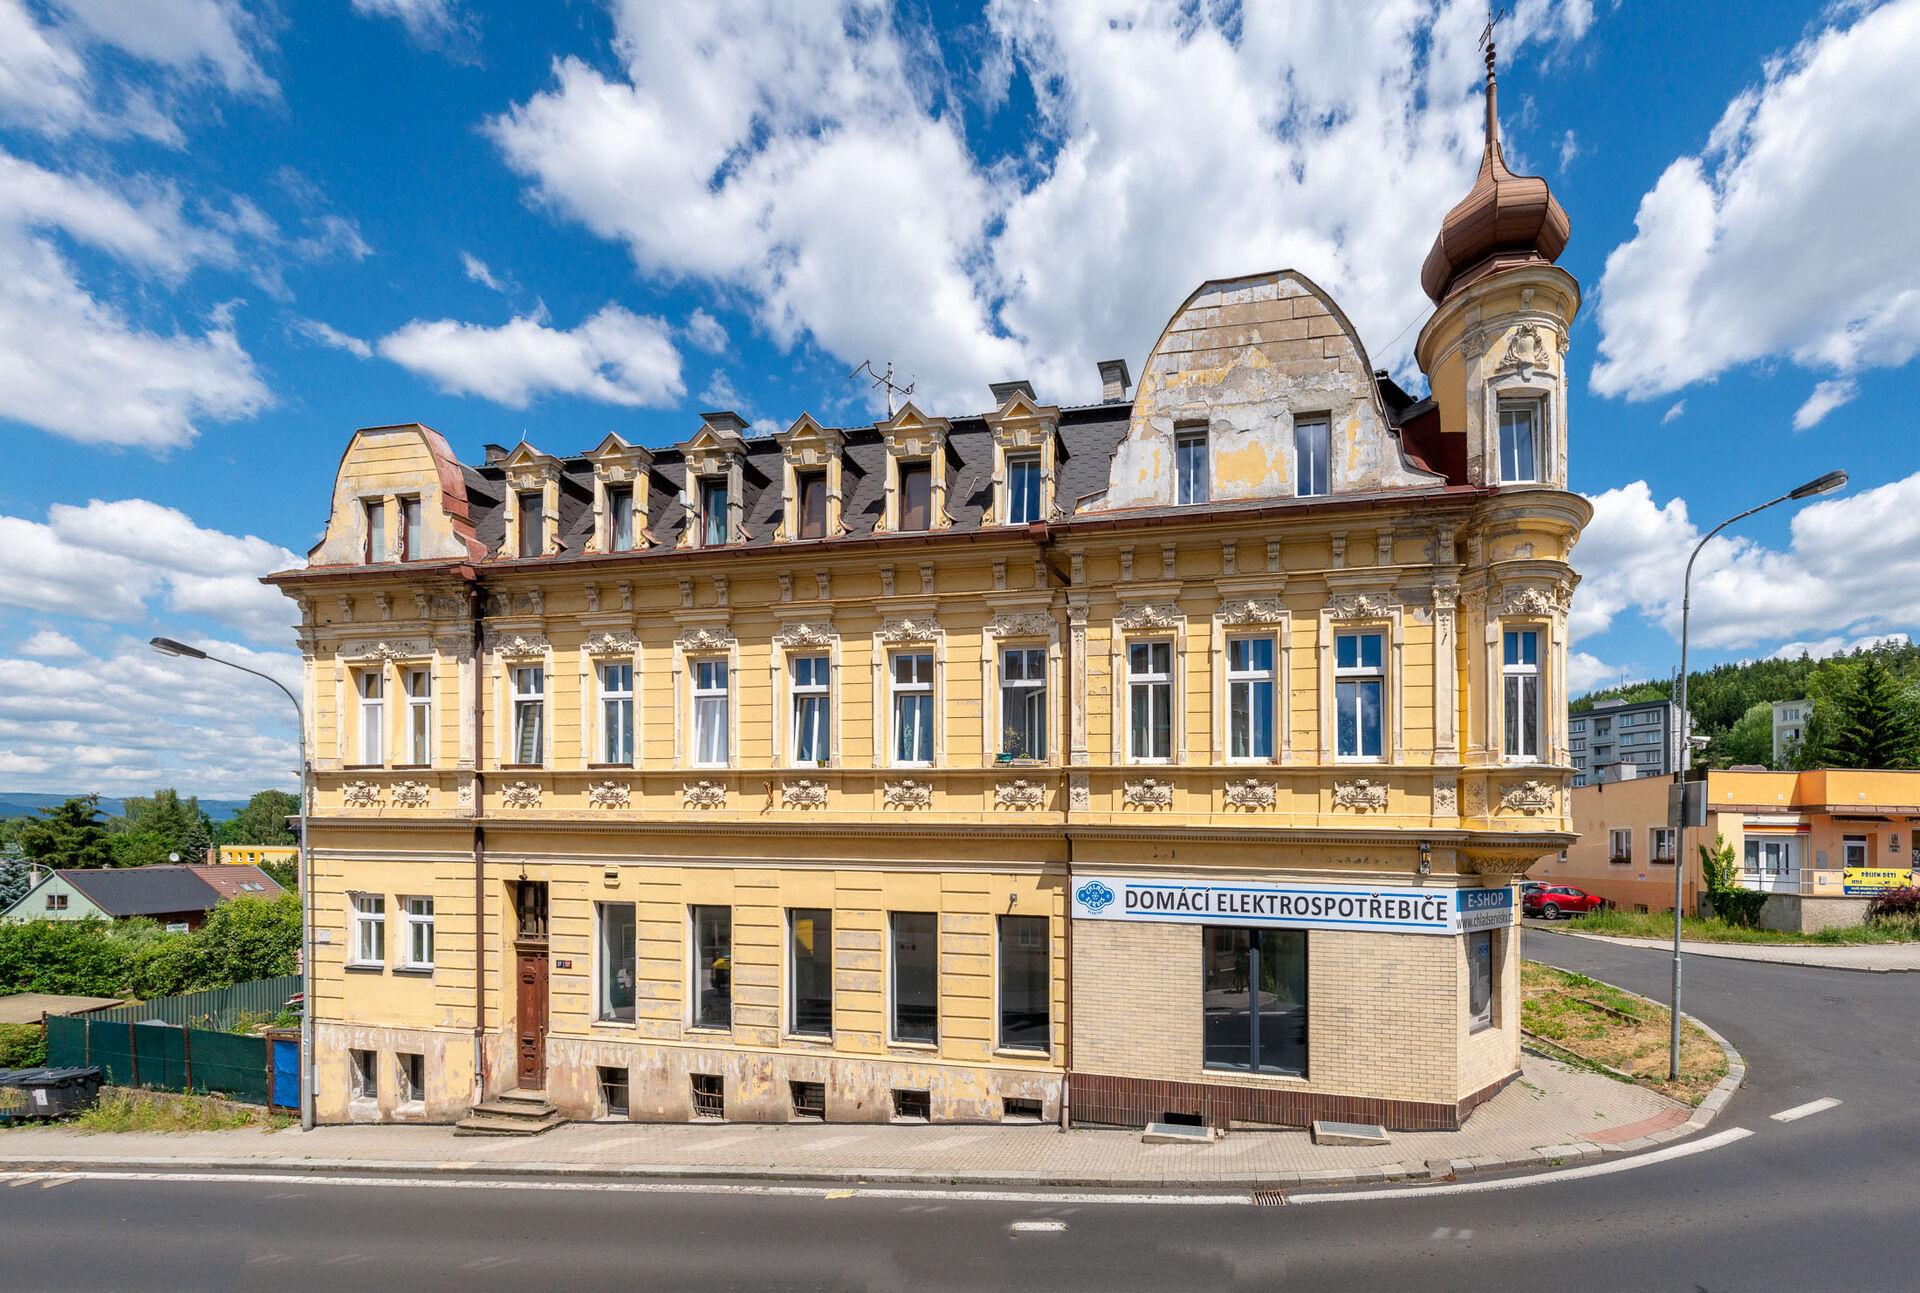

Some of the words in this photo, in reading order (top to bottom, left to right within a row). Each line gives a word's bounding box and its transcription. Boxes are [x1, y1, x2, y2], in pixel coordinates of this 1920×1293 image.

[1085, 884, 1105, 895] CHLAD
[1125, 887, 1211, 911] DOMÁCÍ
[1217, 892, 1448, 921] ELEKTROSPOTŘEBIČE
[1468, 892, 1504, 908] E-SHOP
